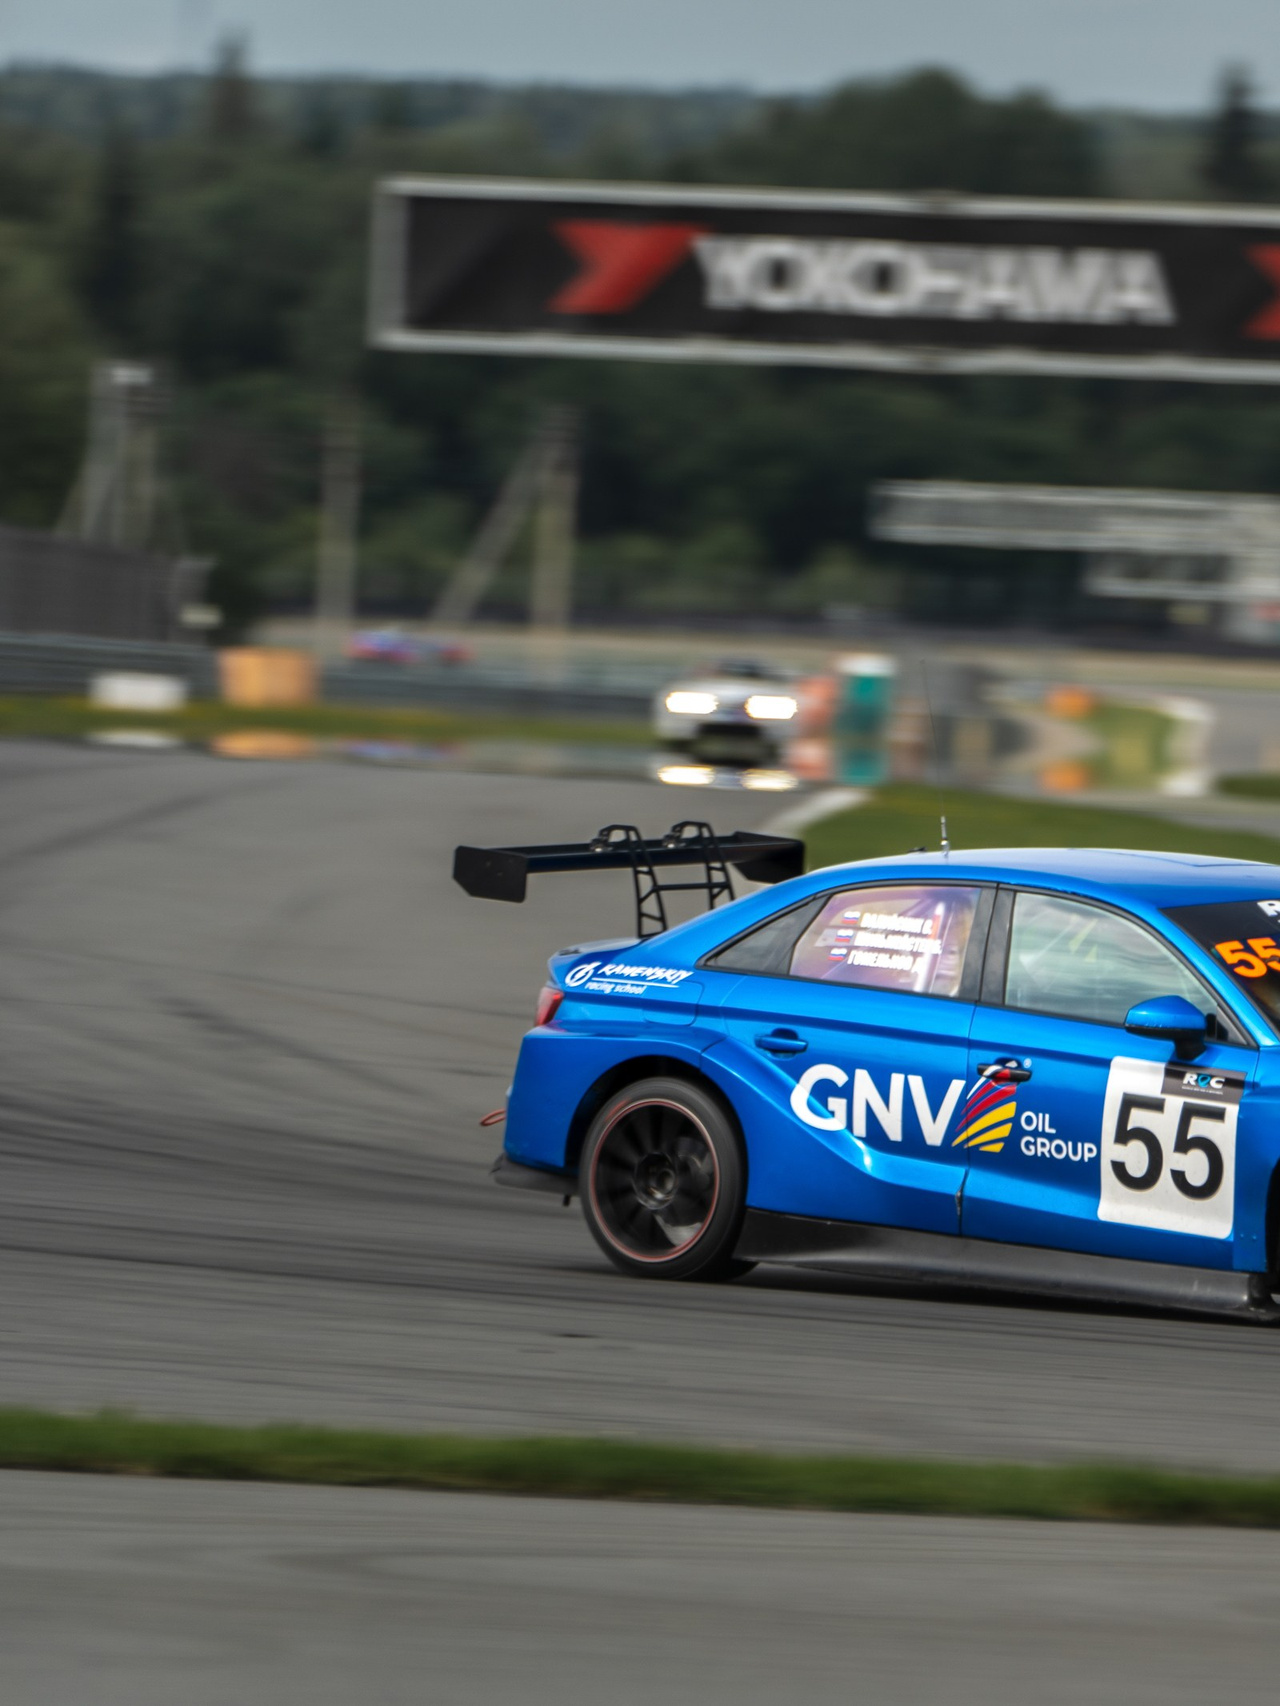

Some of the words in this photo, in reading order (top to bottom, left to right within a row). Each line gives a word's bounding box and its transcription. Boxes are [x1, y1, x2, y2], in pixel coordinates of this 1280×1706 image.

[693, 232, 1176, 325] YOKOHAMA
[585, 981, 615, 994] racing
[614, 983, 647, 994] school
[790, 1063, 966, 1147] GNV
[1020, 1111, 1056, 1134] OIL
[1020, 1136, 1097, 1163] GROUP
[1110, 1092, 1227, 1201] 55
